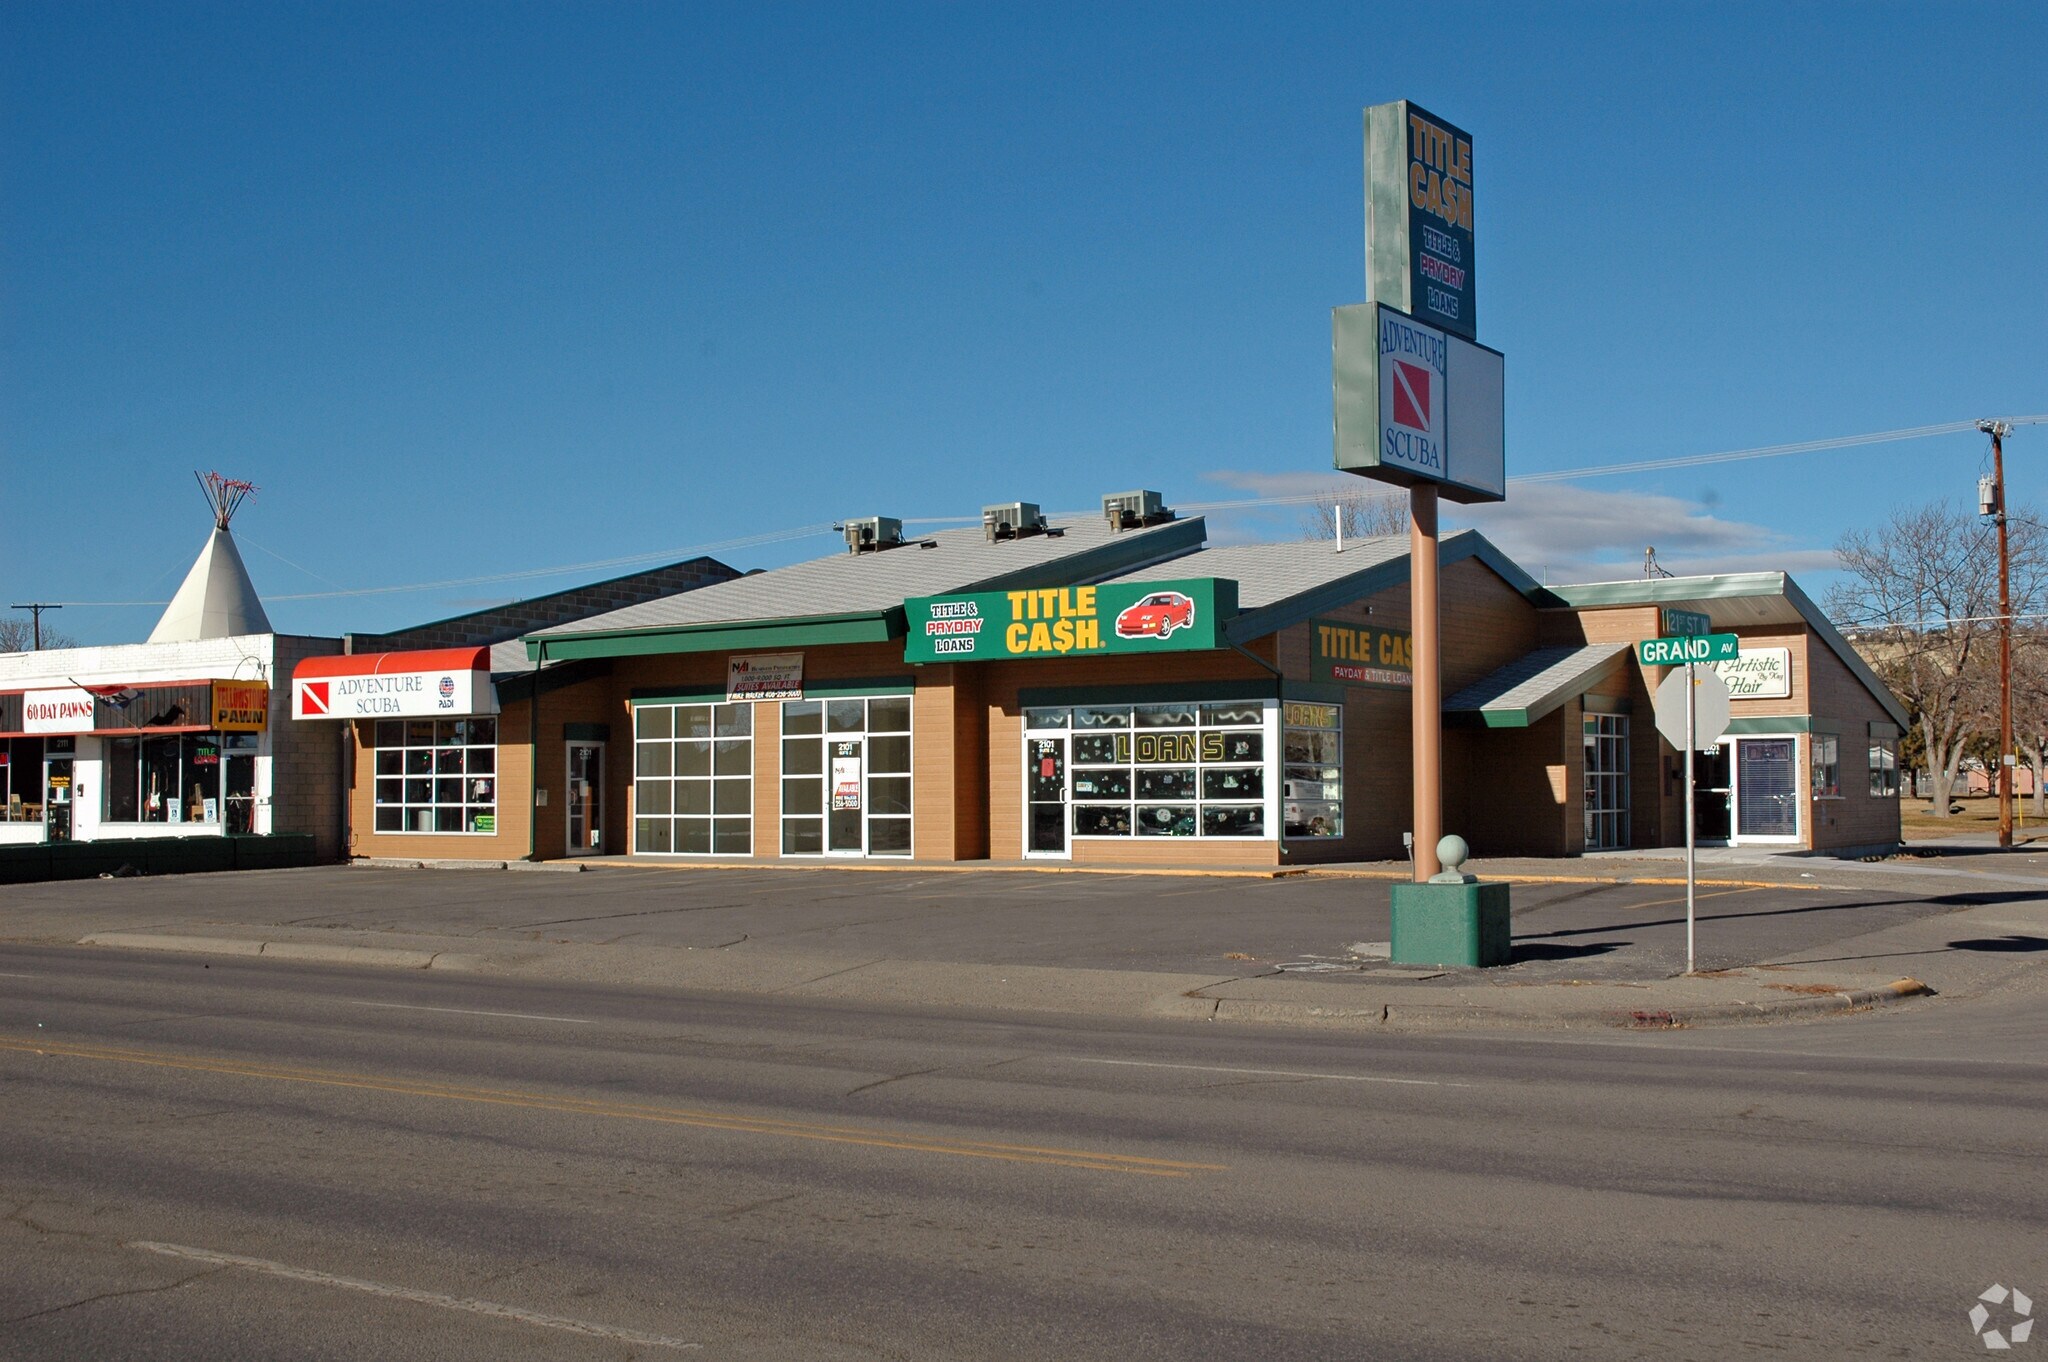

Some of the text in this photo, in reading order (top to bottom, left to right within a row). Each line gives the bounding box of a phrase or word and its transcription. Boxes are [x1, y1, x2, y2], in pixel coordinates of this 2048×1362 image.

[1410, 112, 1471, 185] TITLE
[1410, 161, 1472, 232] CA$H
[1423, 224, 1460, 262] TITLE &
[1420, 252, 1465, 291] PAYDAY
[1427, 286, 1458, 319] LOANS
[1381, 318, 1444, 377] ADVENTURE
[1386, 427, 1440, 470] SCUBA
[931, 602, 979, 618] TITLE &
[1006, 586, 1097, 620] TITLE
[926, 618, 984, 636] PAYDAY
[1005, 617, 1099, 654] CA$H
[1687, 617, 1699, 633] ST
[1701, 618, 1709, 635] W
[935, 638, 975, 653] LOANS
[1318, 625, 1413, 670] TITLE CA$
[1643, 639, 1734, 662] GRAND AV
[732, 660, 749, 674] NAI
[1723, 656, 1780, 673] Artistic
[1334, 666, 1413, 684] PAYDAY & TITLE LOAN
[338, 676, 423, 695] ADVENTURE
[737, 680, 799, 691] SUITES AVAILABLE
[1724, 676, 1762, 694] Hair
[216, 687, 266, 710] YELLOWSTONE
[356, 698, 401, 714] SCUBA
[438, 699, 454, 709] PADI
[27, 701, 93, 720] 60 DAY PAWNS
[218, 709, 263, 724] PAWN
[1284, 704, 1331, 728] LOANS
[197, 747, 216, 756] TITLE
[838, 742, 853, 751] 2101
[1038, 740, 1055, 748] 2101
[1117, 733, 1225, 762] LOANS
